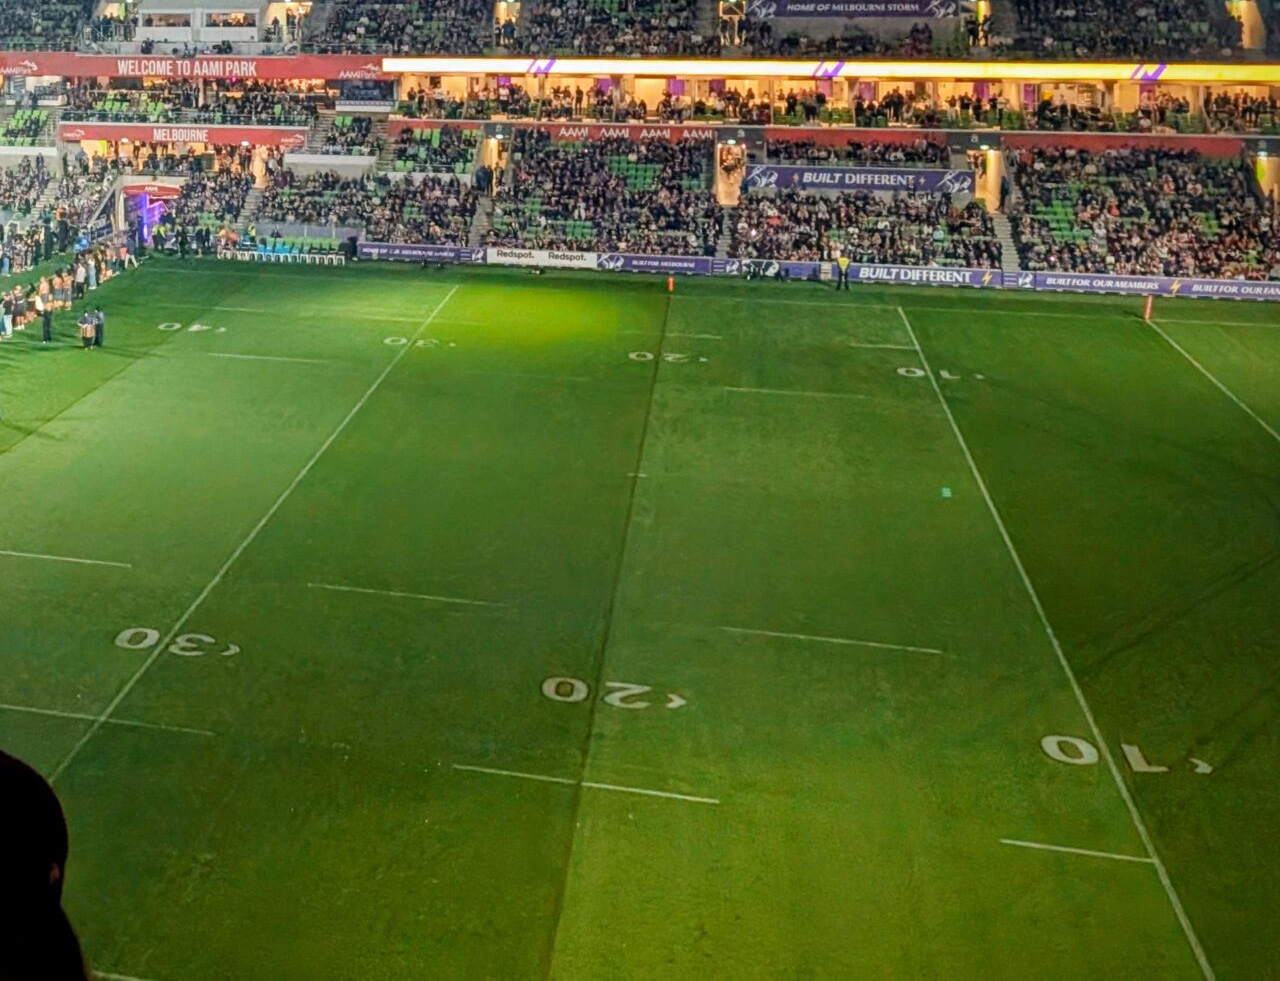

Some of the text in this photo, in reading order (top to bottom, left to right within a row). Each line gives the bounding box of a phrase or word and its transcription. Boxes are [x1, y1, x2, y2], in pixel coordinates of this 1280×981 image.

[832, 3, 885, 11] MELBOURNE
[887, 3, 919, 11] STORM
[117, 60, 257, 76] WELCOME TO AAMI PARK
[339, 70, 360, 78] AAMI
[153, 128, 208, 141] MELBOURNE
[559, 127, 588, 137] AAMI
[600, 128, 629, 138] AAMI
[640, 129, 670, 138] AAMI
[803, 172, 915, 185] BUILT DIFFERENT
[497, 250, 535, 259] Redspot.
[548, 252, 587, 261] Redspot.
[859, 268, 972, 283] BUILT DIFFERENT
[1046, 277, 1071, 285] BUILT
[1092, 279, 1114, 287] OUR
[1113, 280, 1159, 289] MEMBERS
[115, 627, 216, 656] 30
[541, 676, 652, 709] 20
[1041, 735, 1169, 772] 10
